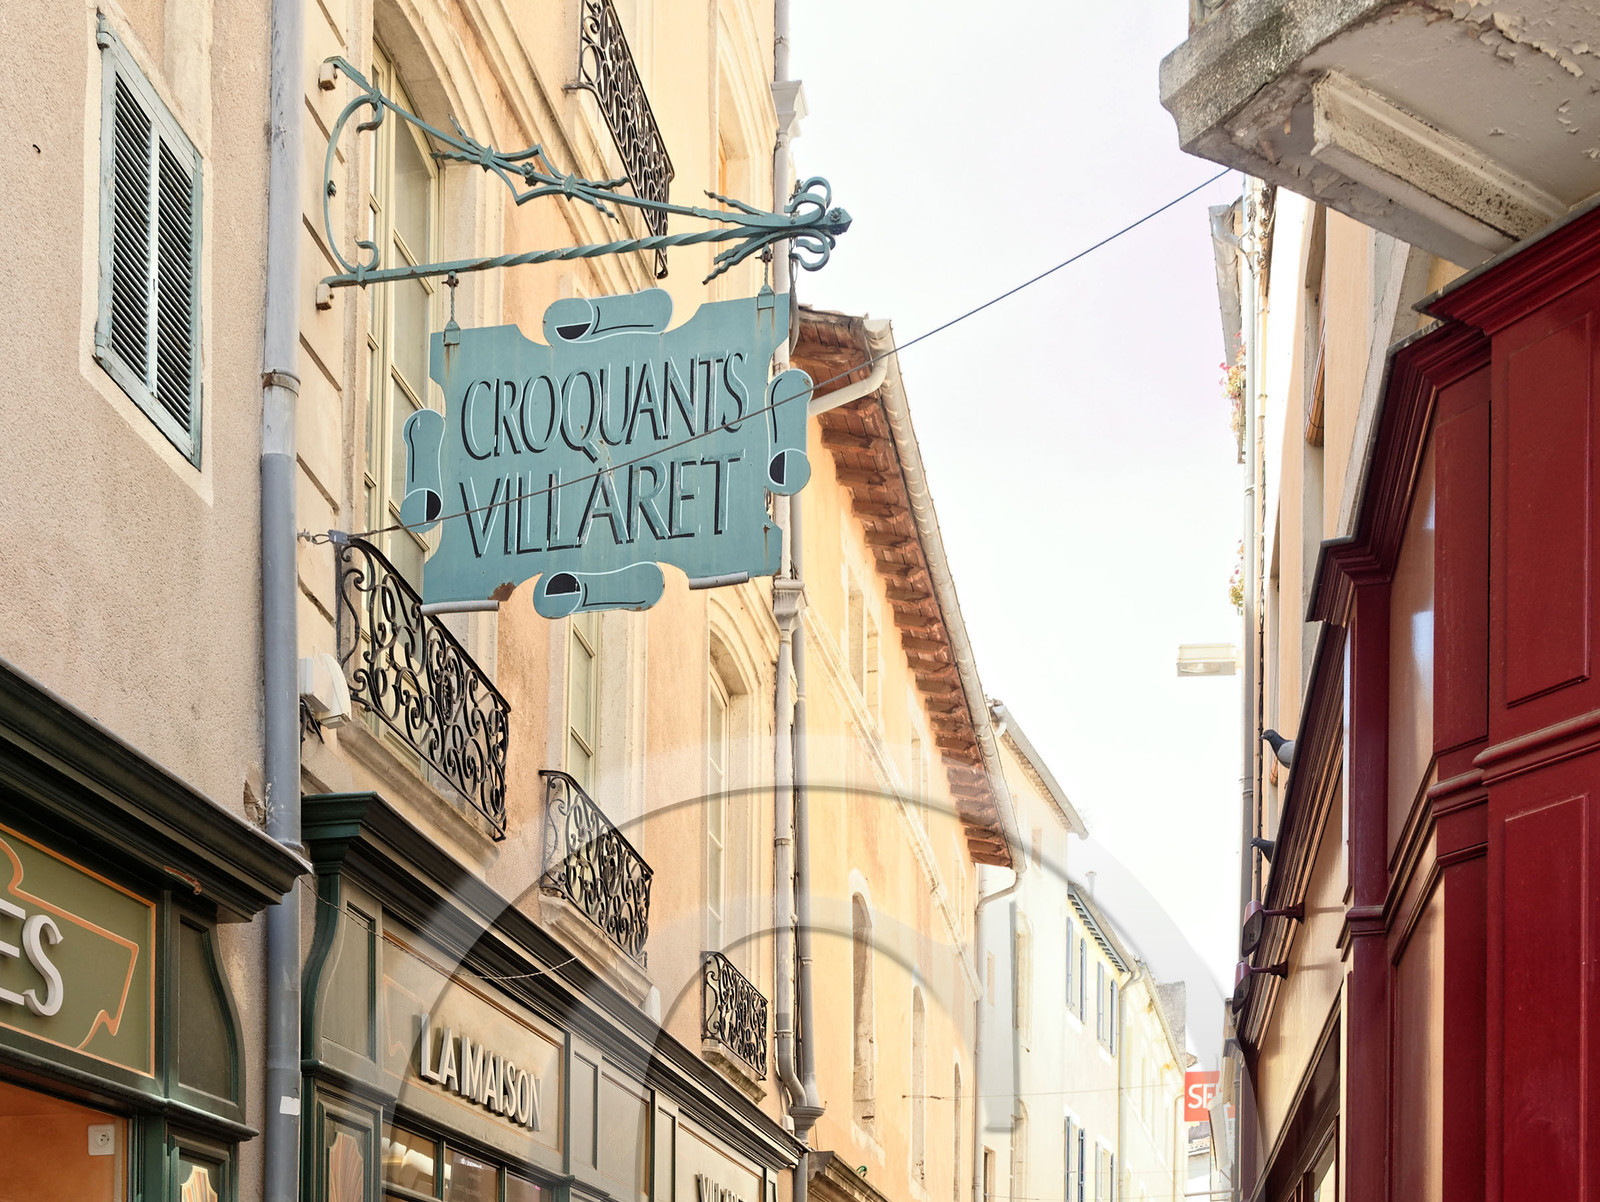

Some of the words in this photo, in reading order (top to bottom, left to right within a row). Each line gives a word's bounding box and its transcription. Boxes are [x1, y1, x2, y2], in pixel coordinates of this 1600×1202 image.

[461, 351, 749, 463] CROQUANTS
[459, 449, 746, 558] VILLARET
[420, 1013, 459, 1092] LA
[461, 1036, 542, 1132] MAISON
